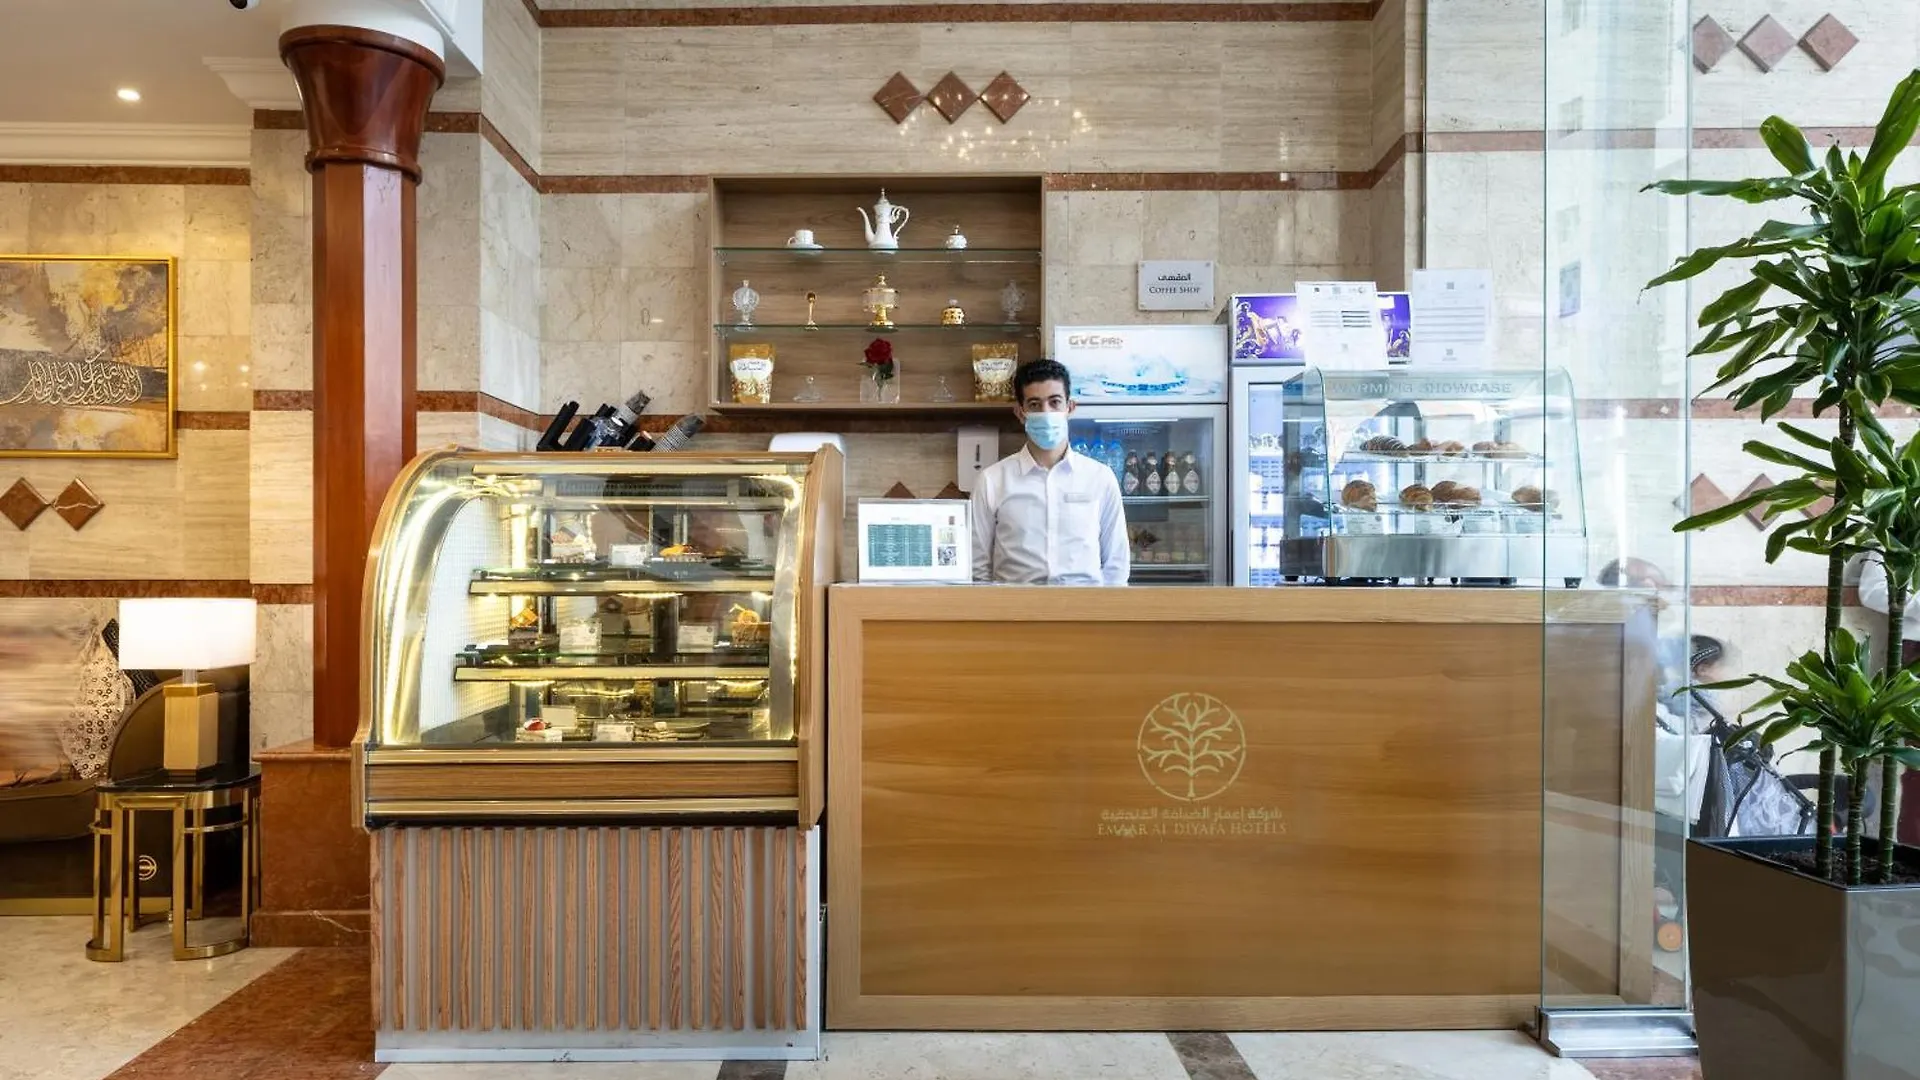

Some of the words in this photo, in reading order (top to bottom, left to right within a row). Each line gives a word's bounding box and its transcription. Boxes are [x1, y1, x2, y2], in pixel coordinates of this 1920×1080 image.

[1179, 286, 1201, 294] SHOP
[1068, 335, 1100, 345] GVC
[1332, 382, 1413, 394] WARMING
[1418, 381, 1512, 394] SHOWCASE
[1174, 822, 1226, 835] DIYAFA
[1230, 822, 1287, 834] HOTELS
